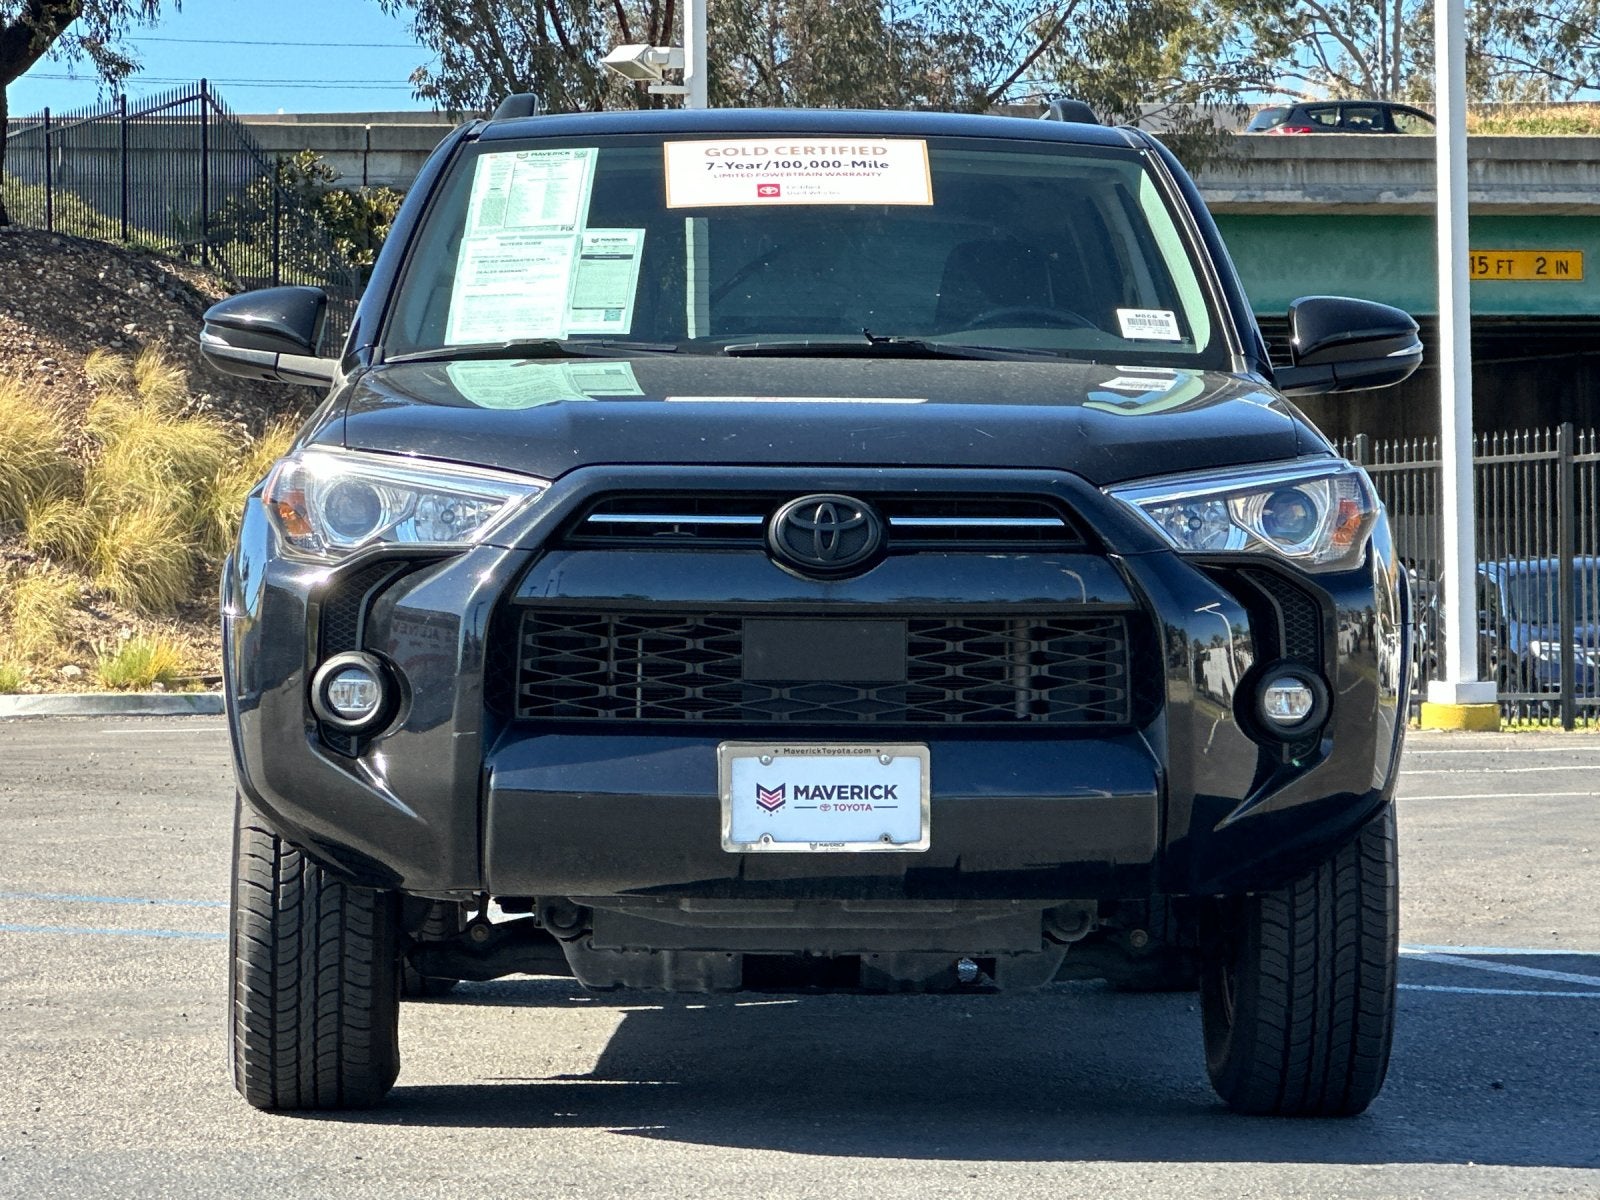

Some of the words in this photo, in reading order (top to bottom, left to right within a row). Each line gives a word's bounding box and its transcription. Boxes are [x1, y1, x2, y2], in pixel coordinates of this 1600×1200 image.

[705, 147, 768, 157] GOLD
[774, 146, 888, 156] CERTIFIED
[706, 160, 889, 170] 7-Year/100,000-Mile
[1470, 256, 1489, 274] 15
[1496, 260, 1514, 274] FT
[1536, 257, 1547, 274] 2
[1556, 260, 1568, 274] IN
[794, 785, 898, 800] MAVERICK
[833, 803, 873, 812] TOYOTA
